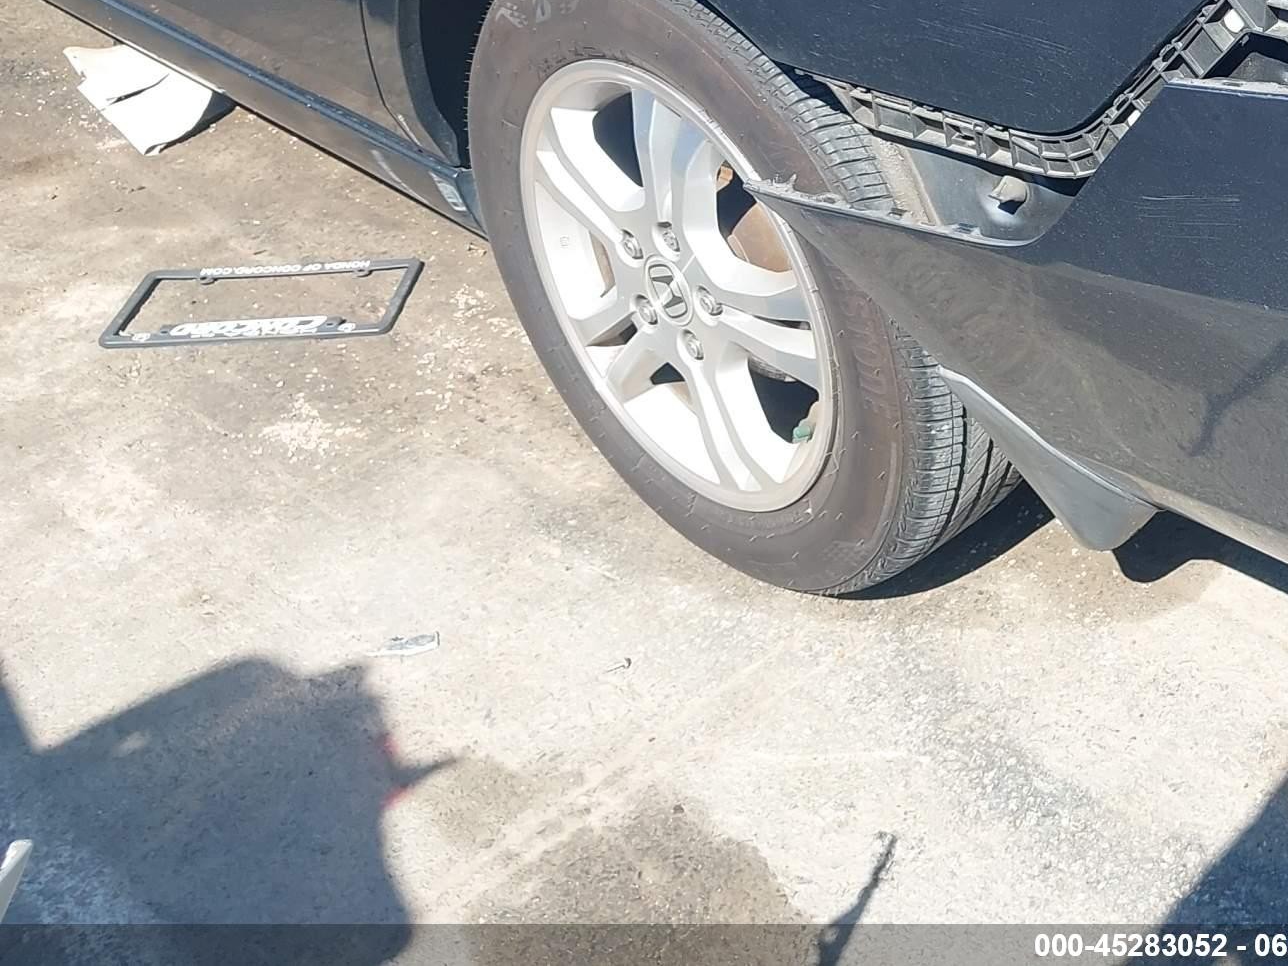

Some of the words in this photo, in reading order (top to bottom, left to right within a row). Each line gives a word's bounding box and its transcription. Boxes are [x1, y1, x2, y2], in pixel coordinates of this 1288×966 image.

[200, 264, 301, 276] CONCORD.COM
[302, 263, 322, 272] OF
[324, 260, 370, 271] HONDA
